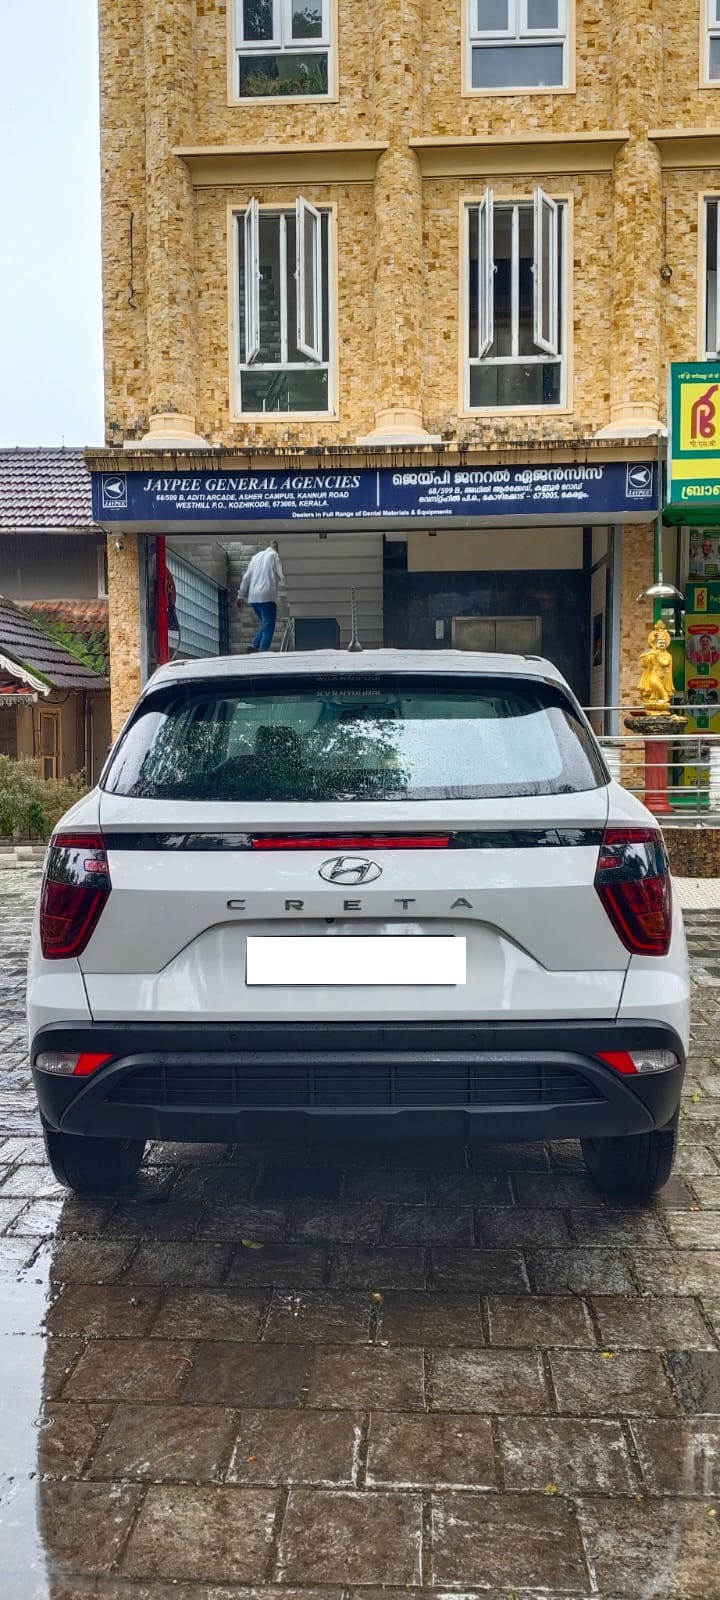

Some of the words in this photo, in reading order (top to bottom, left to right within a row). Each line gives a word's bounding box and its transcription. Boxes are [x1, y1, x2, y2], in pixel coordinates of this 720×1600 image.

[144, 478, 202, 491] JAYPEE
[205, 477, 278, 491] GENERAL
[280, 475, 361, 490] AGENCIES
[264, 492, 296, 500] CAMPUS,
[176, 501, 211, 509] WESTHILL
[228, 501, 271, 509] KOZHIKODE,
[335, 511, 354, 519] Range
[226, 897, 473, 911] CRETA
